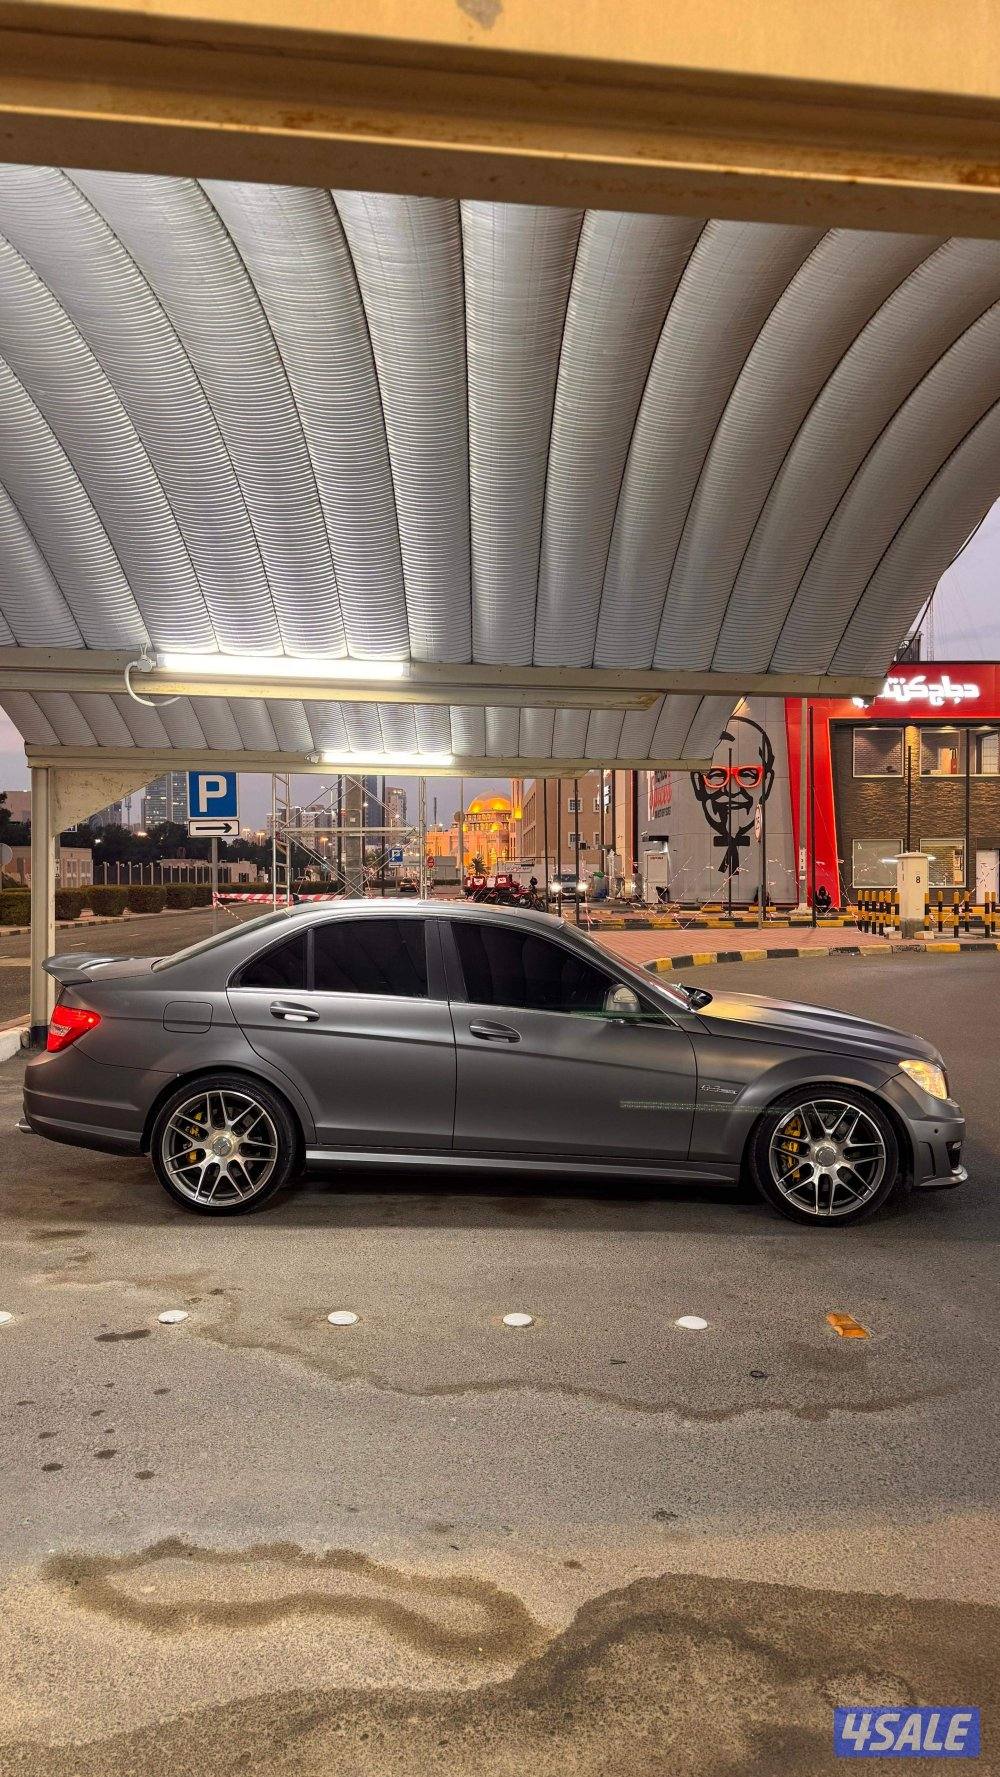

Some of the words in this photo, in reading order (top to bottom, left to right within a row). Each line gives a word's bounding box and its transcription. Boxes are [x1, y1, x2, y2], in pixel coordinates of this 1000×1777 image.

[928, 675, 979, 706] دجاج
[198, 774, 227, 812] P
[391, 849, 401, 861] P
[915, 875, 921, 883] 8
